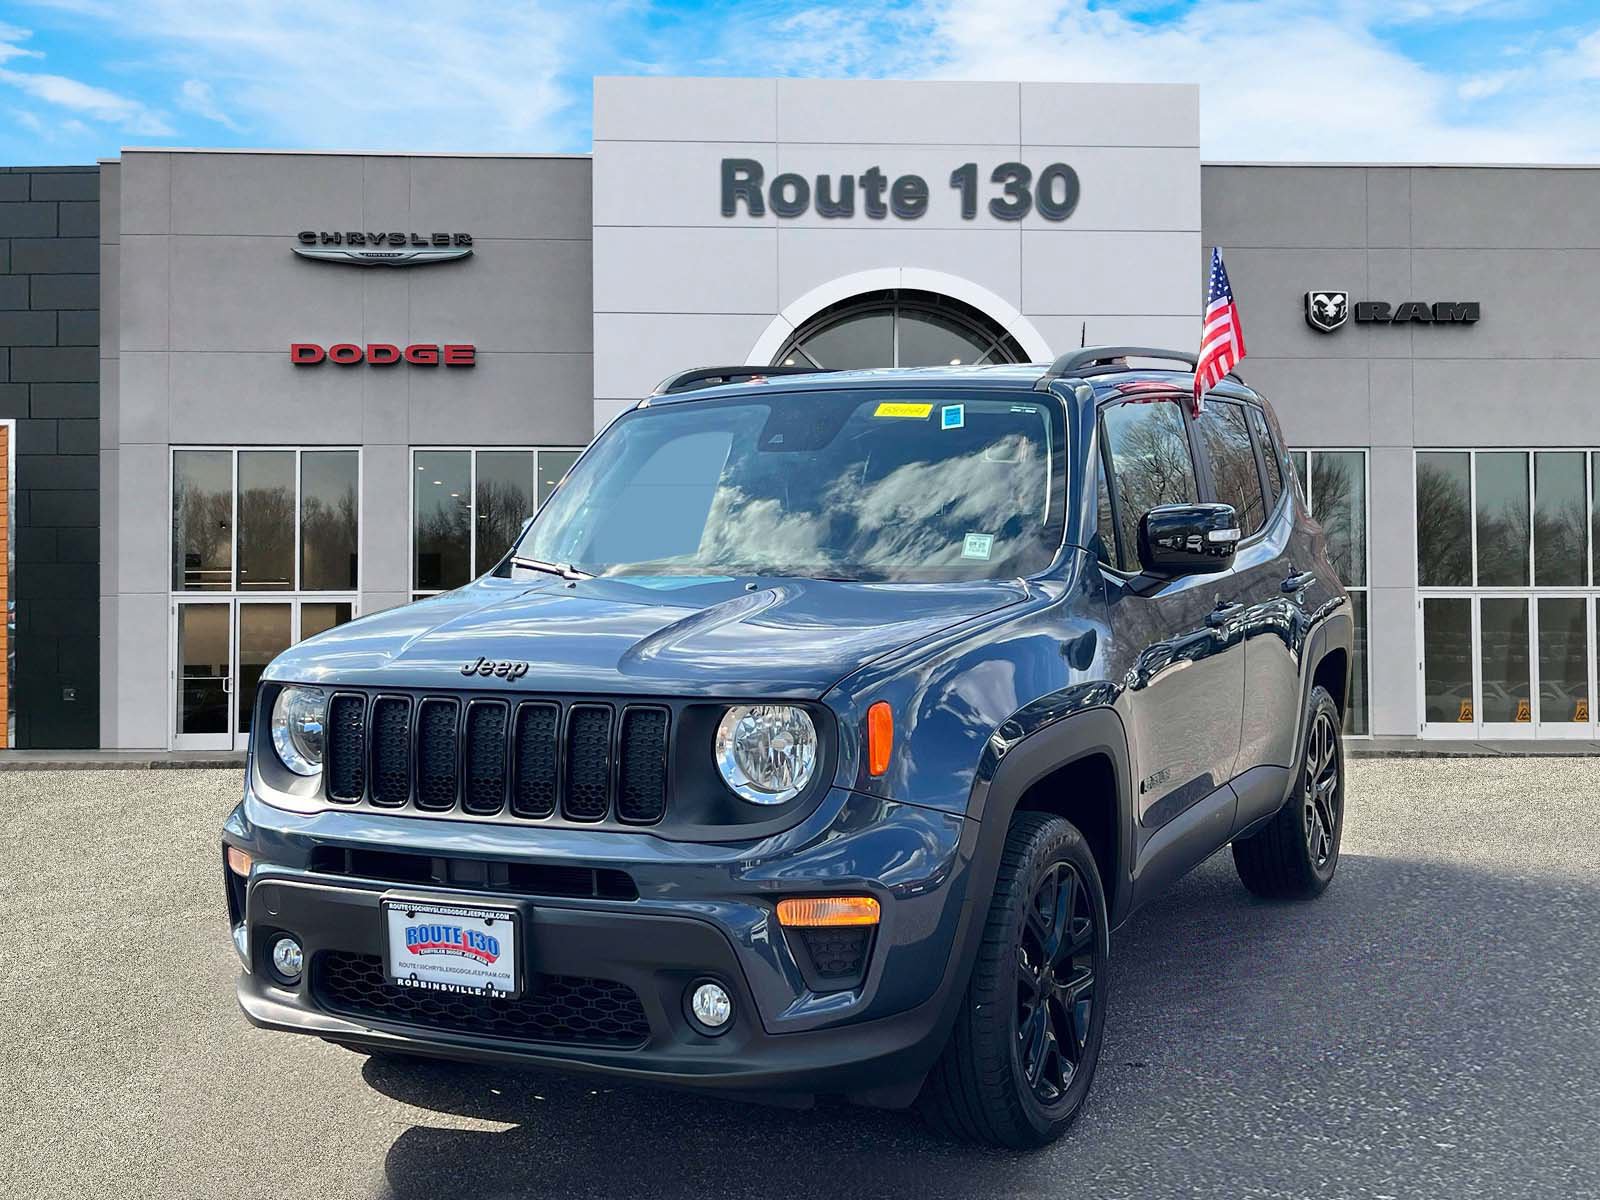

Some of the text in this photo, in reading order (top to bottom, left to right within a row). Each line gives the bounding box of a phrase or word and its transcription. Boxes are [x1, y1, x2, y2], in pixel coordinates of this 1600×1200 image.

[720, 158, 1080, 221] Route 130
[298, 231, 473, 246] CHRYSLER
[1355, 302, 1480, 324] RAM
[291, 343, 476, 366] DODGE
[461, 656, 530, 682] Jeep
[405, 924, 500, 959] ROUTE 130
[397, 978, 507, 999] ROBBINSVILLE, NJ
